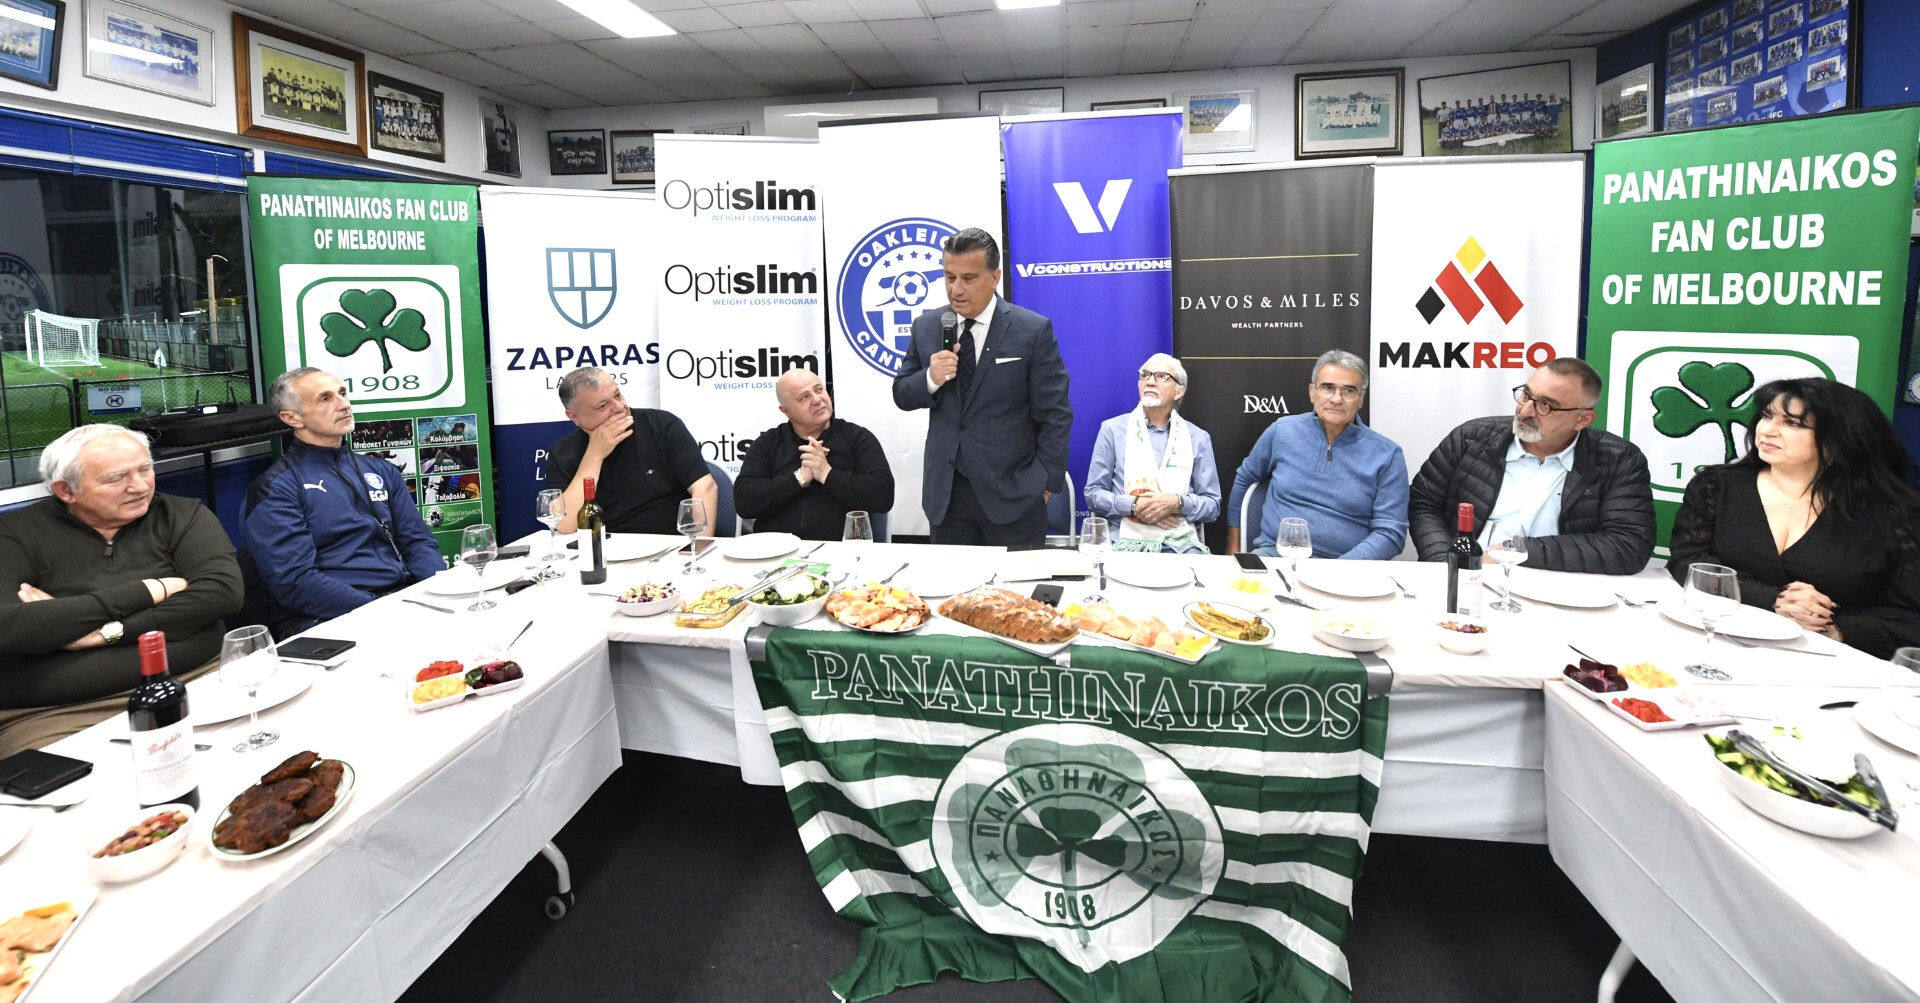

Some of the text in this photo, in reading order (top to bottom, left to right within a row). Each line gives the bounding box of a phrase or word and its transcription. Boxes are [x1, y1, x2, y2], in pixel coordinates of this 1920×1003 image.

[1603, 149, 1898, 205] PANATHINAIKOS
[260, 194, 469, 222] PANATHINAIKOS FAN CLUB
[663, 180, 816, 217] Optislim
[314, 229, 426, 251] OF MELBOURNE
[1651, 213, 1825, 252] FAN CLUB
[664, 264, 817, 301] Optislim
[1602, 270, 1883, 306] OF MELBOURNE
[712, 298, 747, 306] WEIGHT
[1180, 292, 1360, 310] DAVOS & MILES
[507, 342, 660, 371] ZAPARAS
[666, 347, 819, 386] Optislim
[1379, 341, 1557, 369] MAKREO
[343, 375, 420, 393] 1908
[1243, 395, 1290, 414] D&M
[807, 650, 1362, 740] PANATHINAIKOS
[1044, 891, 1096, 921] 1908
